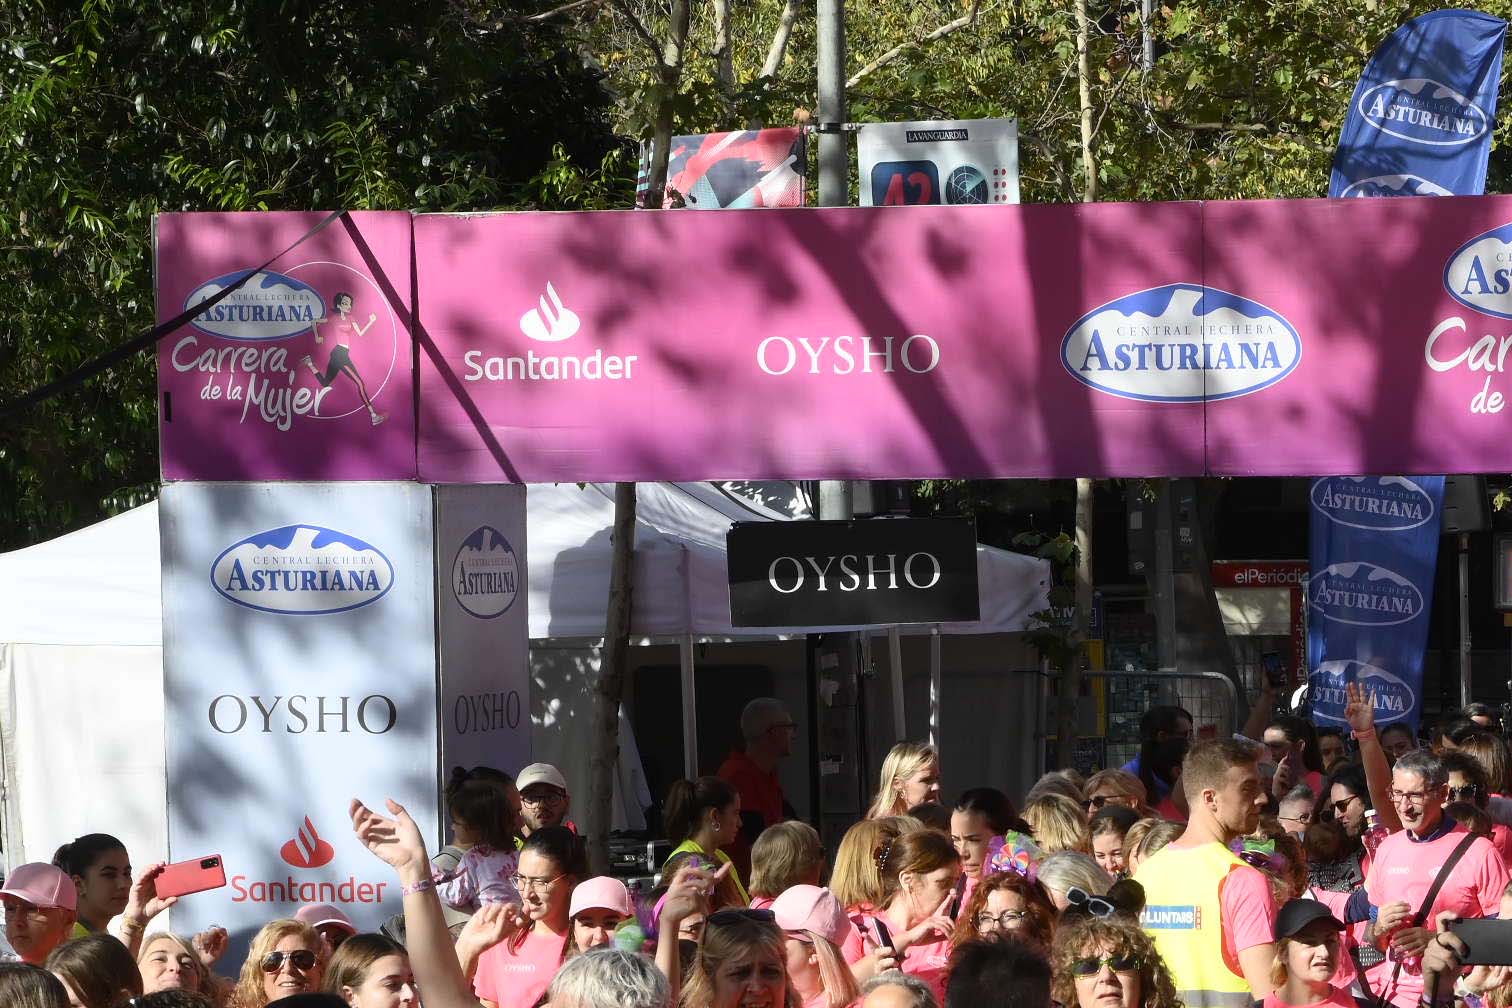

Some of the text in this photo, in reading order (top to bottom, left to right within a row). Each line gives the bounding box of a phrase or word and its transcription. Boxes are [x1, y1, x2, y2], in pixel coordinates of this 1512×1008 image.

[1366, 92, 1476, 137] ASTURIANA
[195, 295, 314, 323] ASTURIANA
[1116, 324, 1275, 337] CENTRAL LECHERA
[171, 336, 288, 373] Carrera
[464, 350, 638, 382] Santander
[756, 334, 941, 376] OYSHO
[1080, 329, 1282, 373] ASTURIANA
[200, 371, 333, 432] de la Mujer
[1470, 376, 1507, 415] de
[1319, 483, 1423, 520] ASTURIANA
[226, 558, 381, 593] ASTURIANA
[253, 555, 375, 566] CENTRAL LECHERA
[457, 561, 515, 596] ASTURIANA
[768, 552, 941, 595] OYSHO
[1315, 579, 1414, 615] ASTURIANA
[208, 694, 398, 736] OYSHO
[454, 690, 521, 735] OYSHO
[231, 875, 387, 904] Santander
